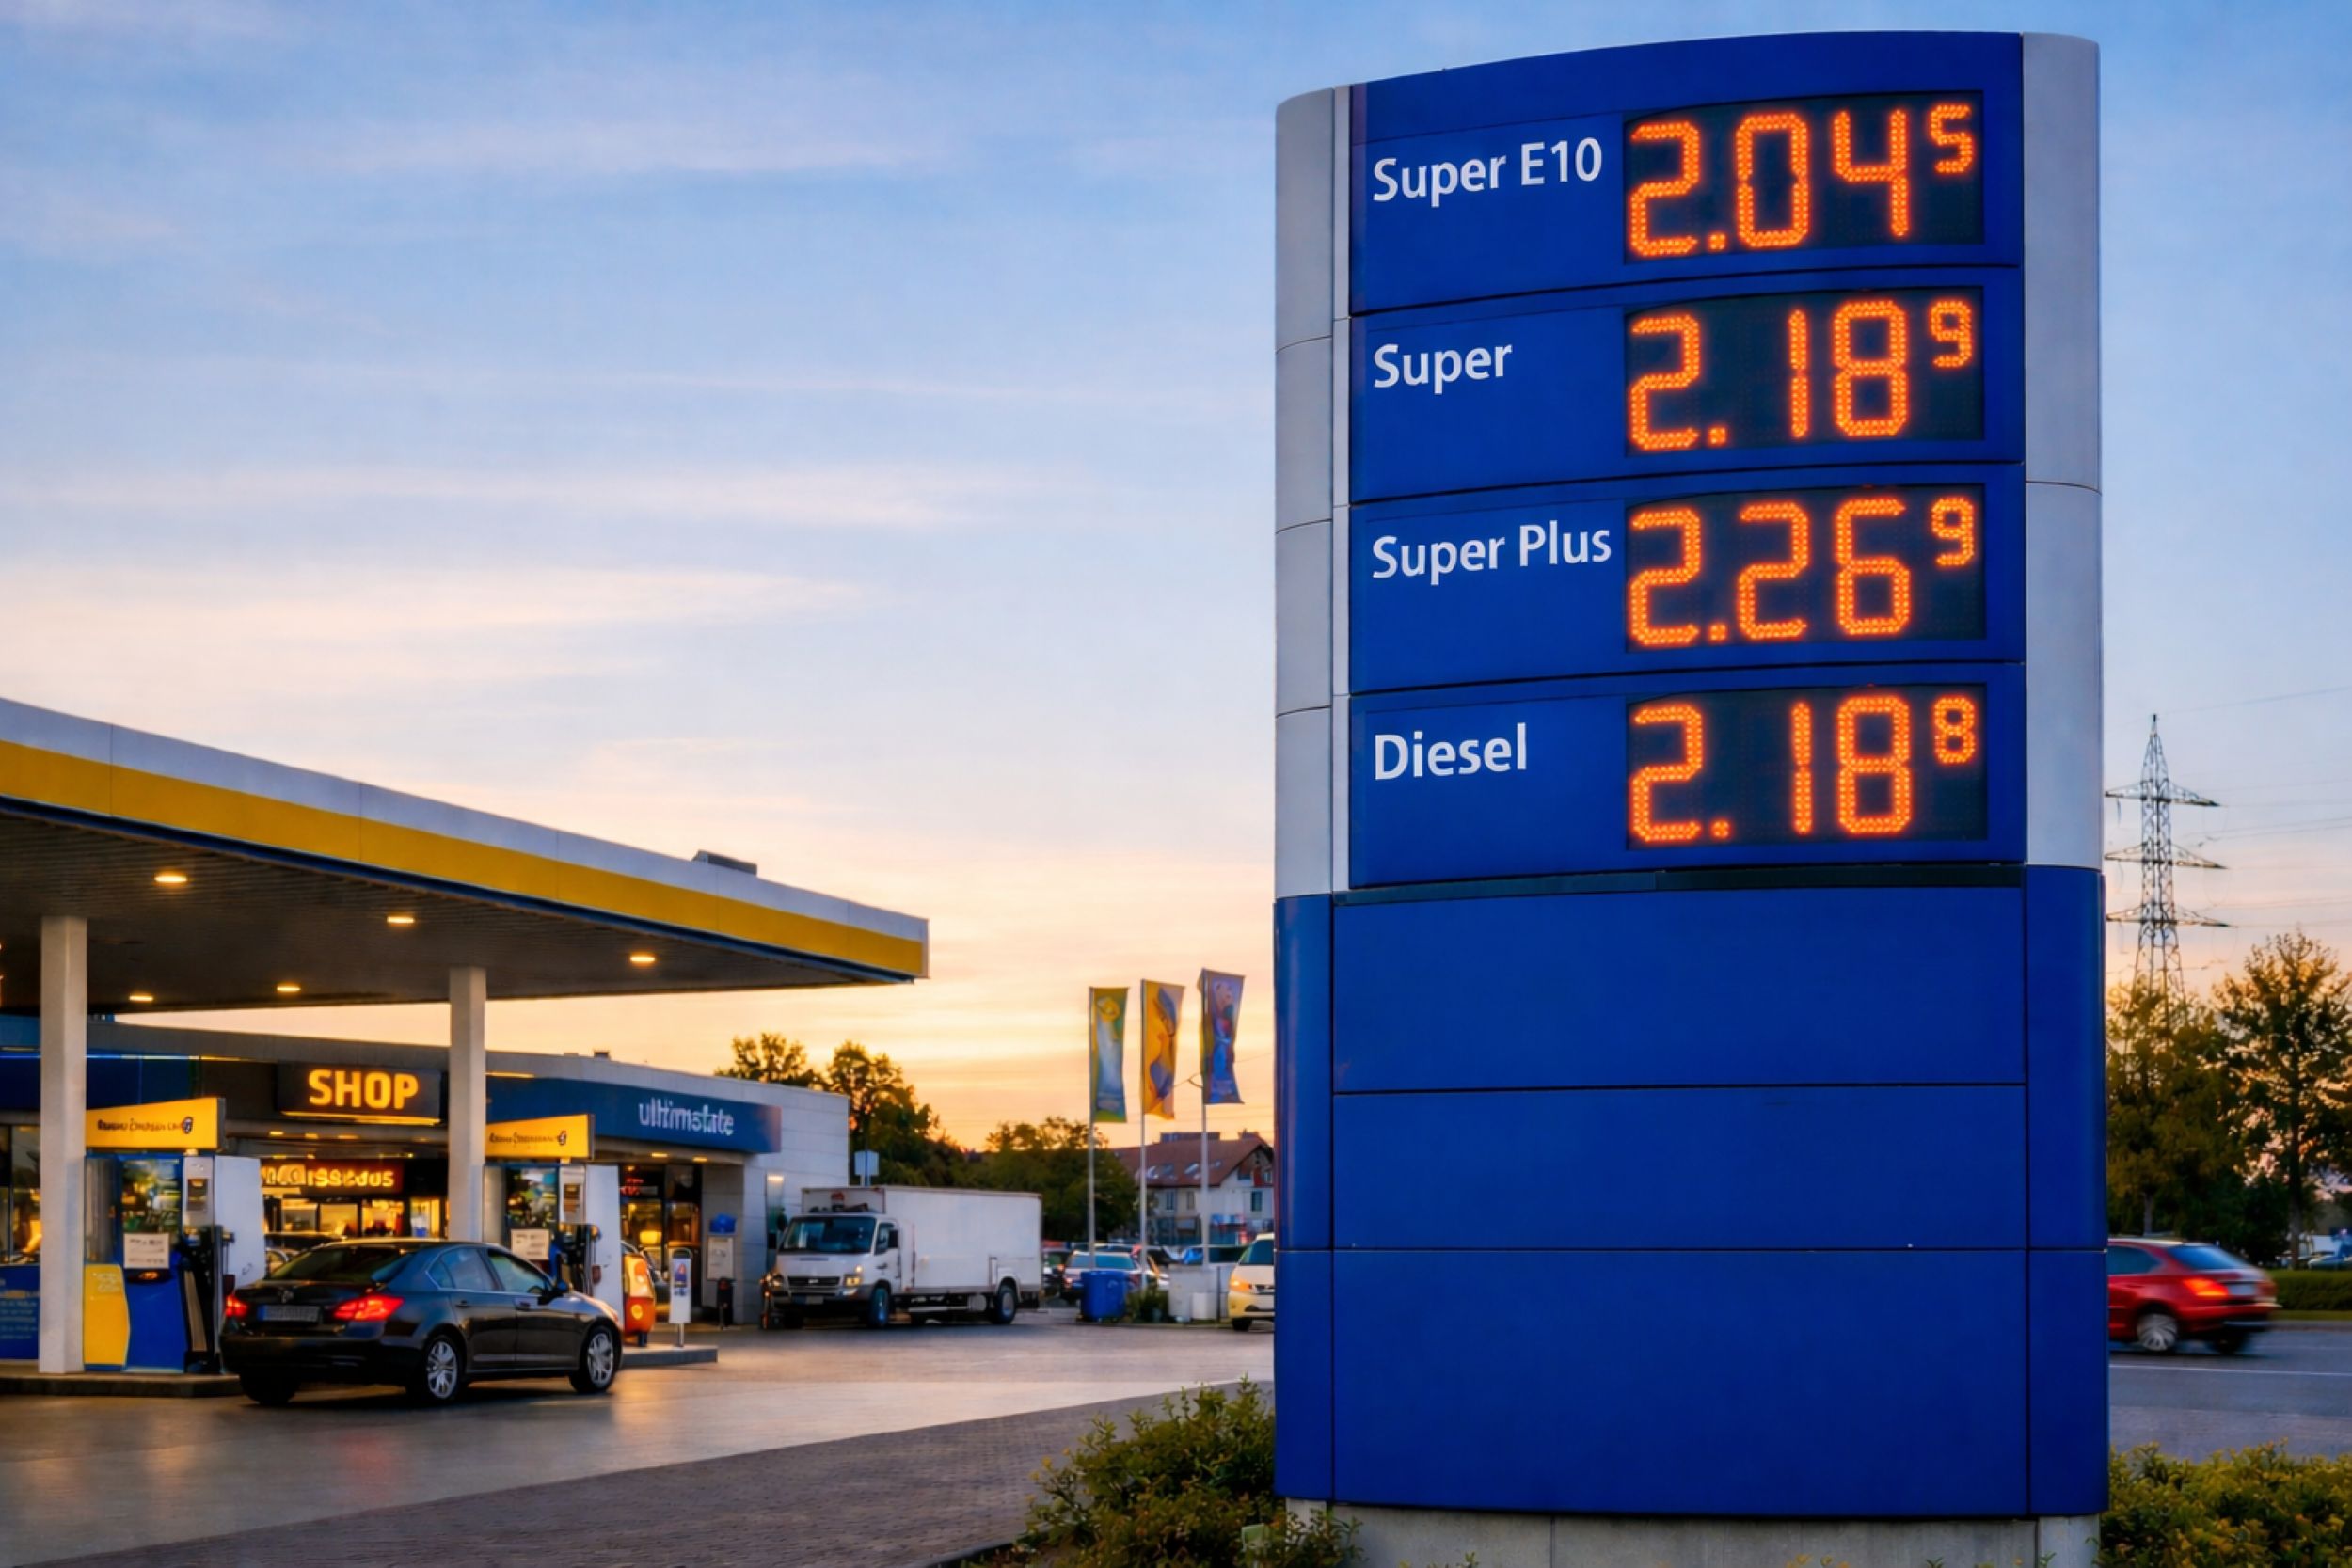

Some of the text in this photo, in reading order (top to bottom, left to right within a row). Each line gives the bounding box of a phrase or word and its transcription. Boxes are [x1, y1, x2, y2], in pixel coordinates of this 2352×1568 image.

[1373, 137, 1602, 208] Super E10
[1373, 343, 1512, 394] Super
[1372, 520, 1612, 586] Super Plus
[1374, 722, 1527, 780] Diesel
[308, 1069, 419, 1110] SHOP
